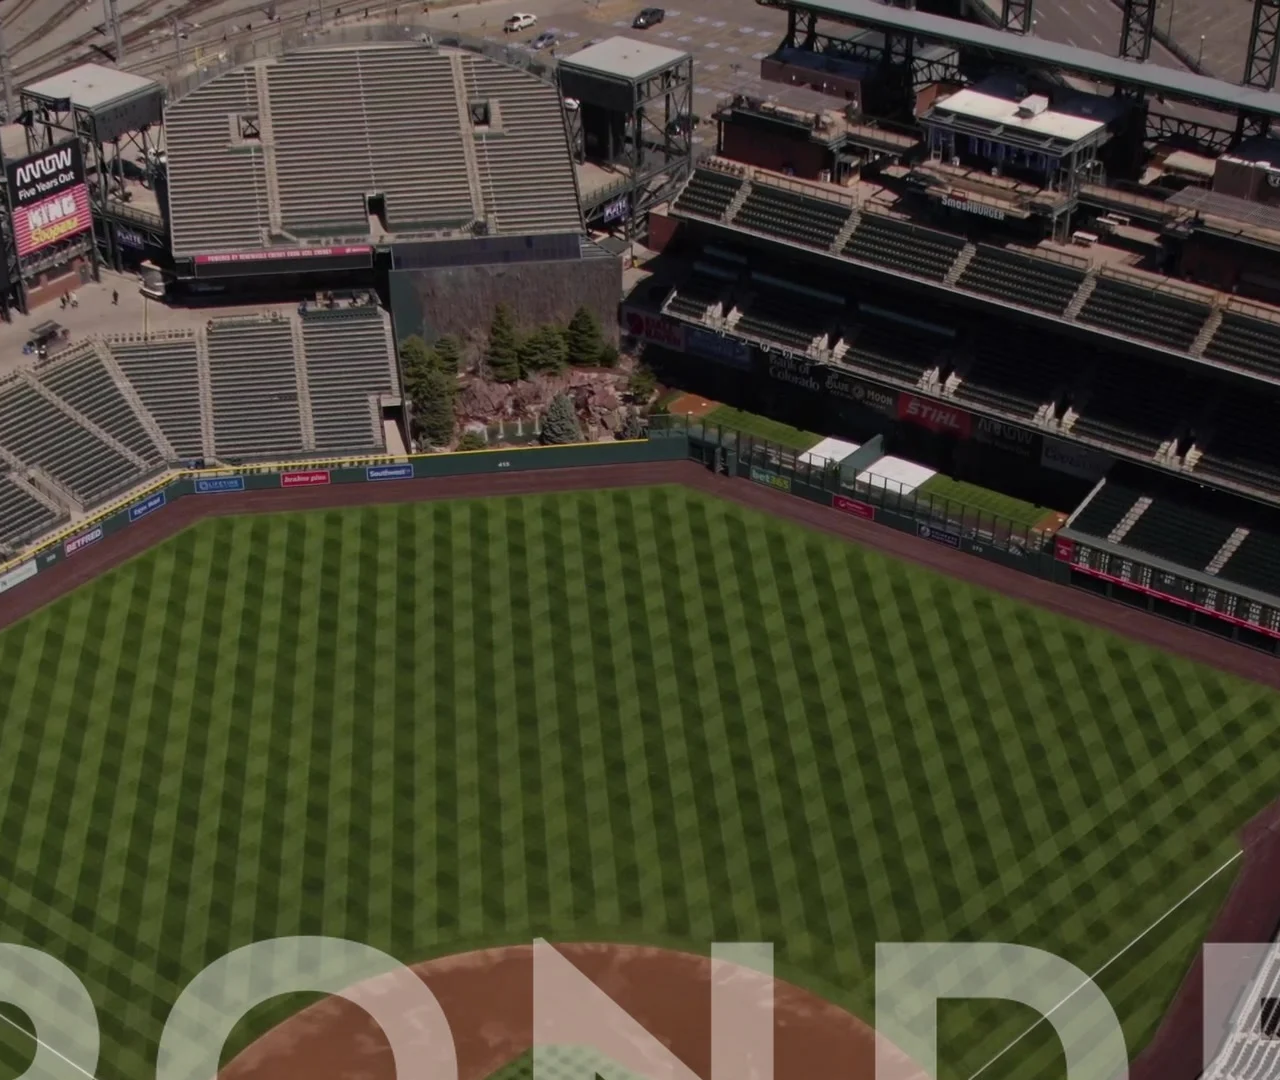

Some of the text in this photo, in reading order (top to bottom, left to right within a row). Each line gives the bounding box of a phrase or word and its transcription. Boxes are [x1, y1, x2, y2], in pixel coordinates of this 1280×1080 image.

[16, 148, 72, 186] ARROW
[18, 170, 75, 201] Five Years Out
[28, 195, 77, 231] KING
[906, 398, 960, 430] STIHL
[66, 528, 102, 553] BETFRED
